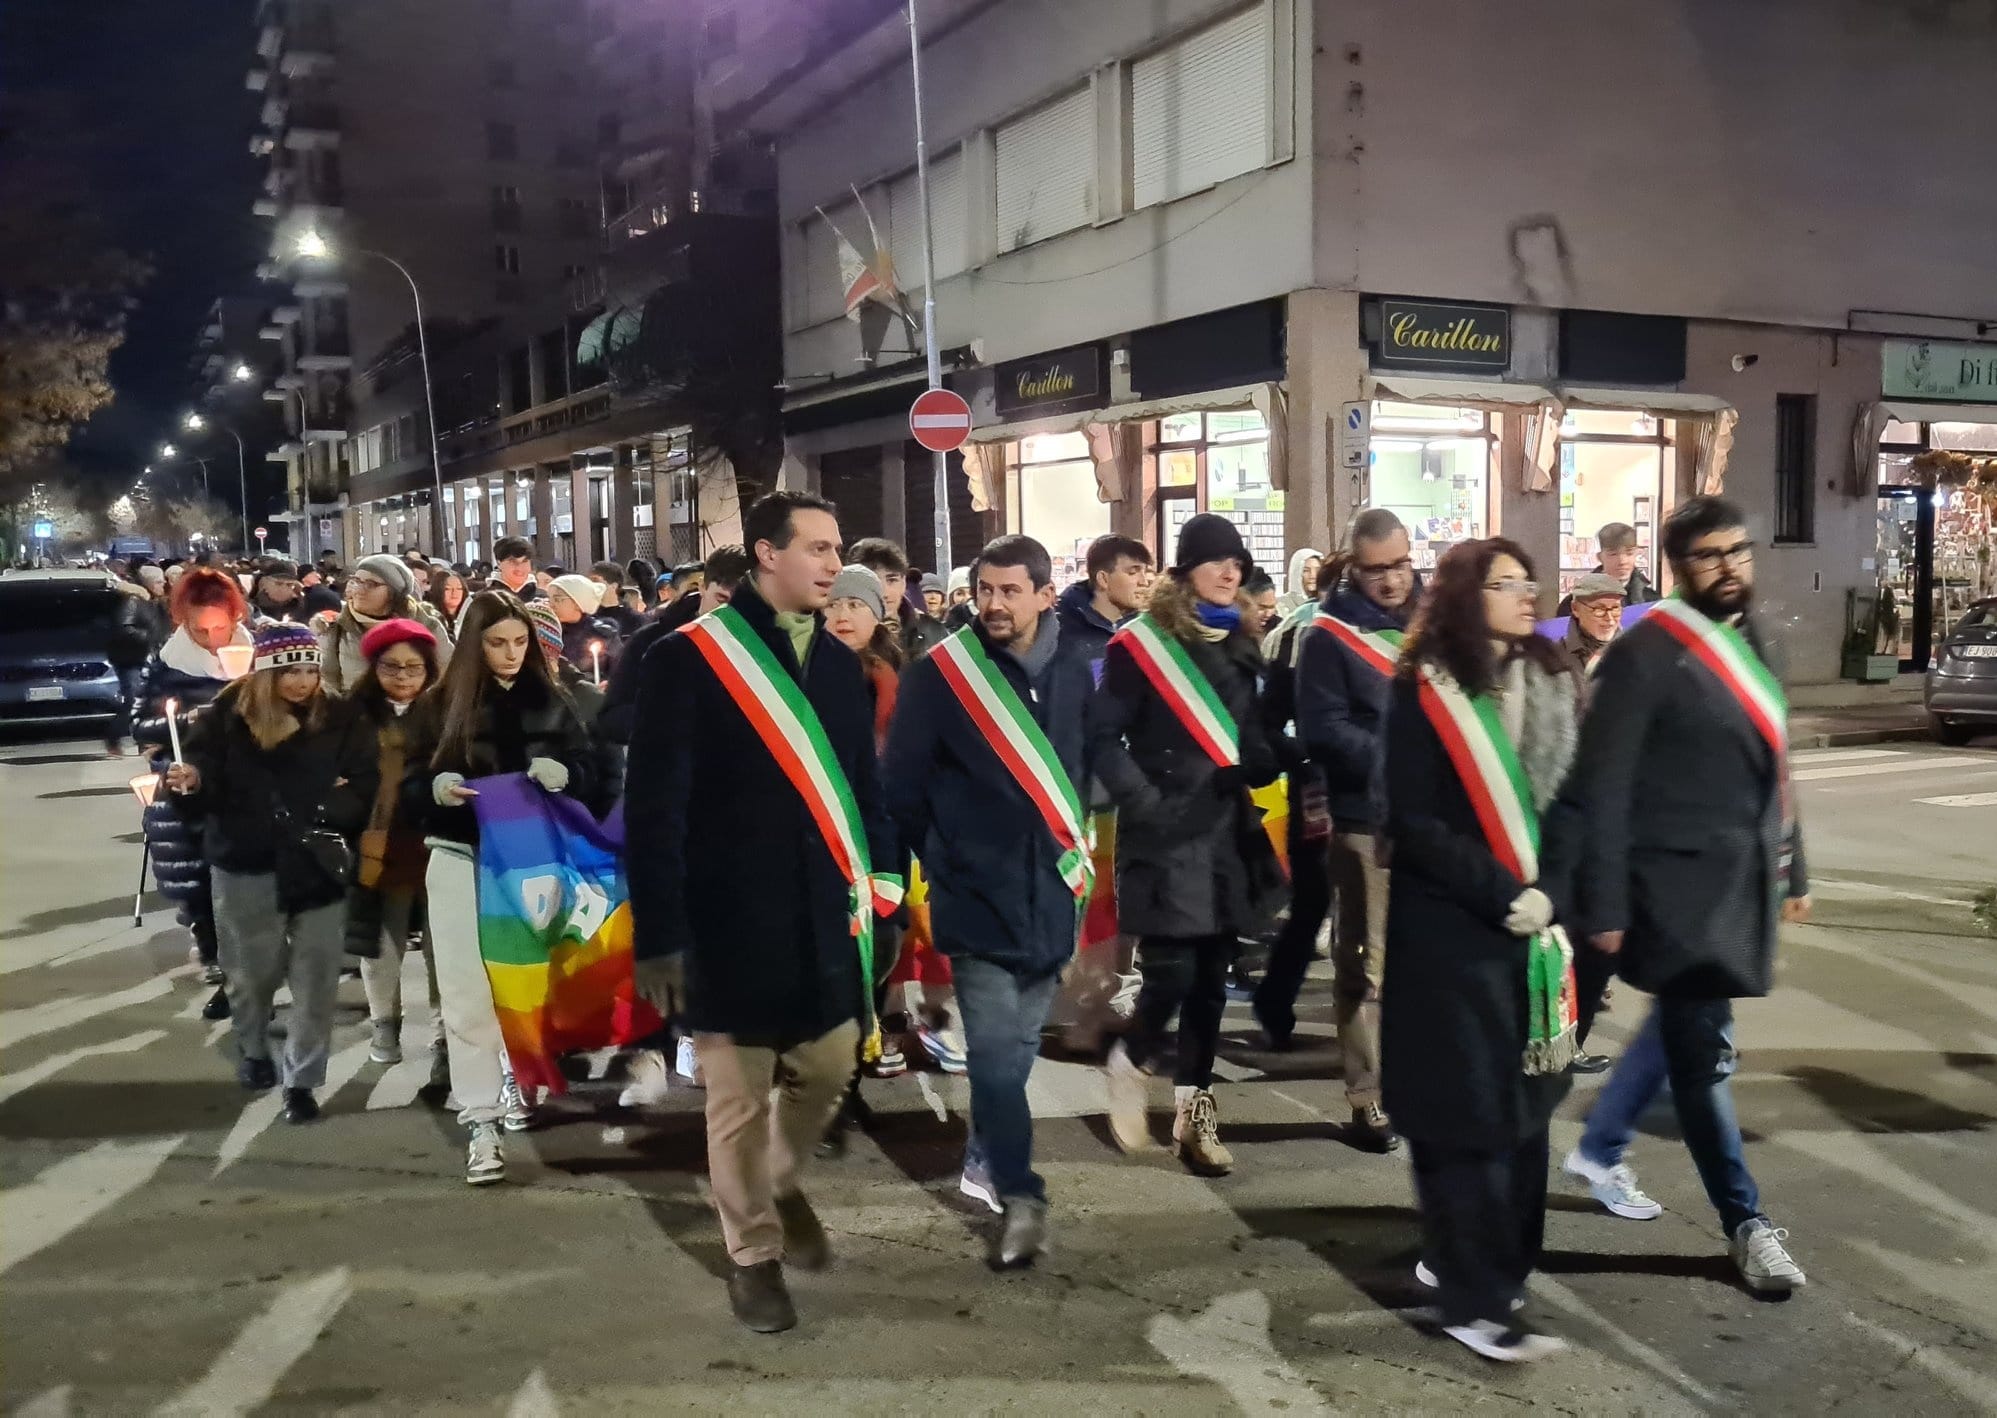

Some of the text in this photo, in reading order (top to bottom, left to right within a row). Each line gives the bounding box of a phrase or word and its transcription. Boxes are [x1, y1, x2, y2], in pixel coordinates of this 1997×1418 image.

[1390, 312, 1500, 352] Carillon
[1017, 365, 1073, 399] Carillon
[1959, 359, 1980, 385] Di
